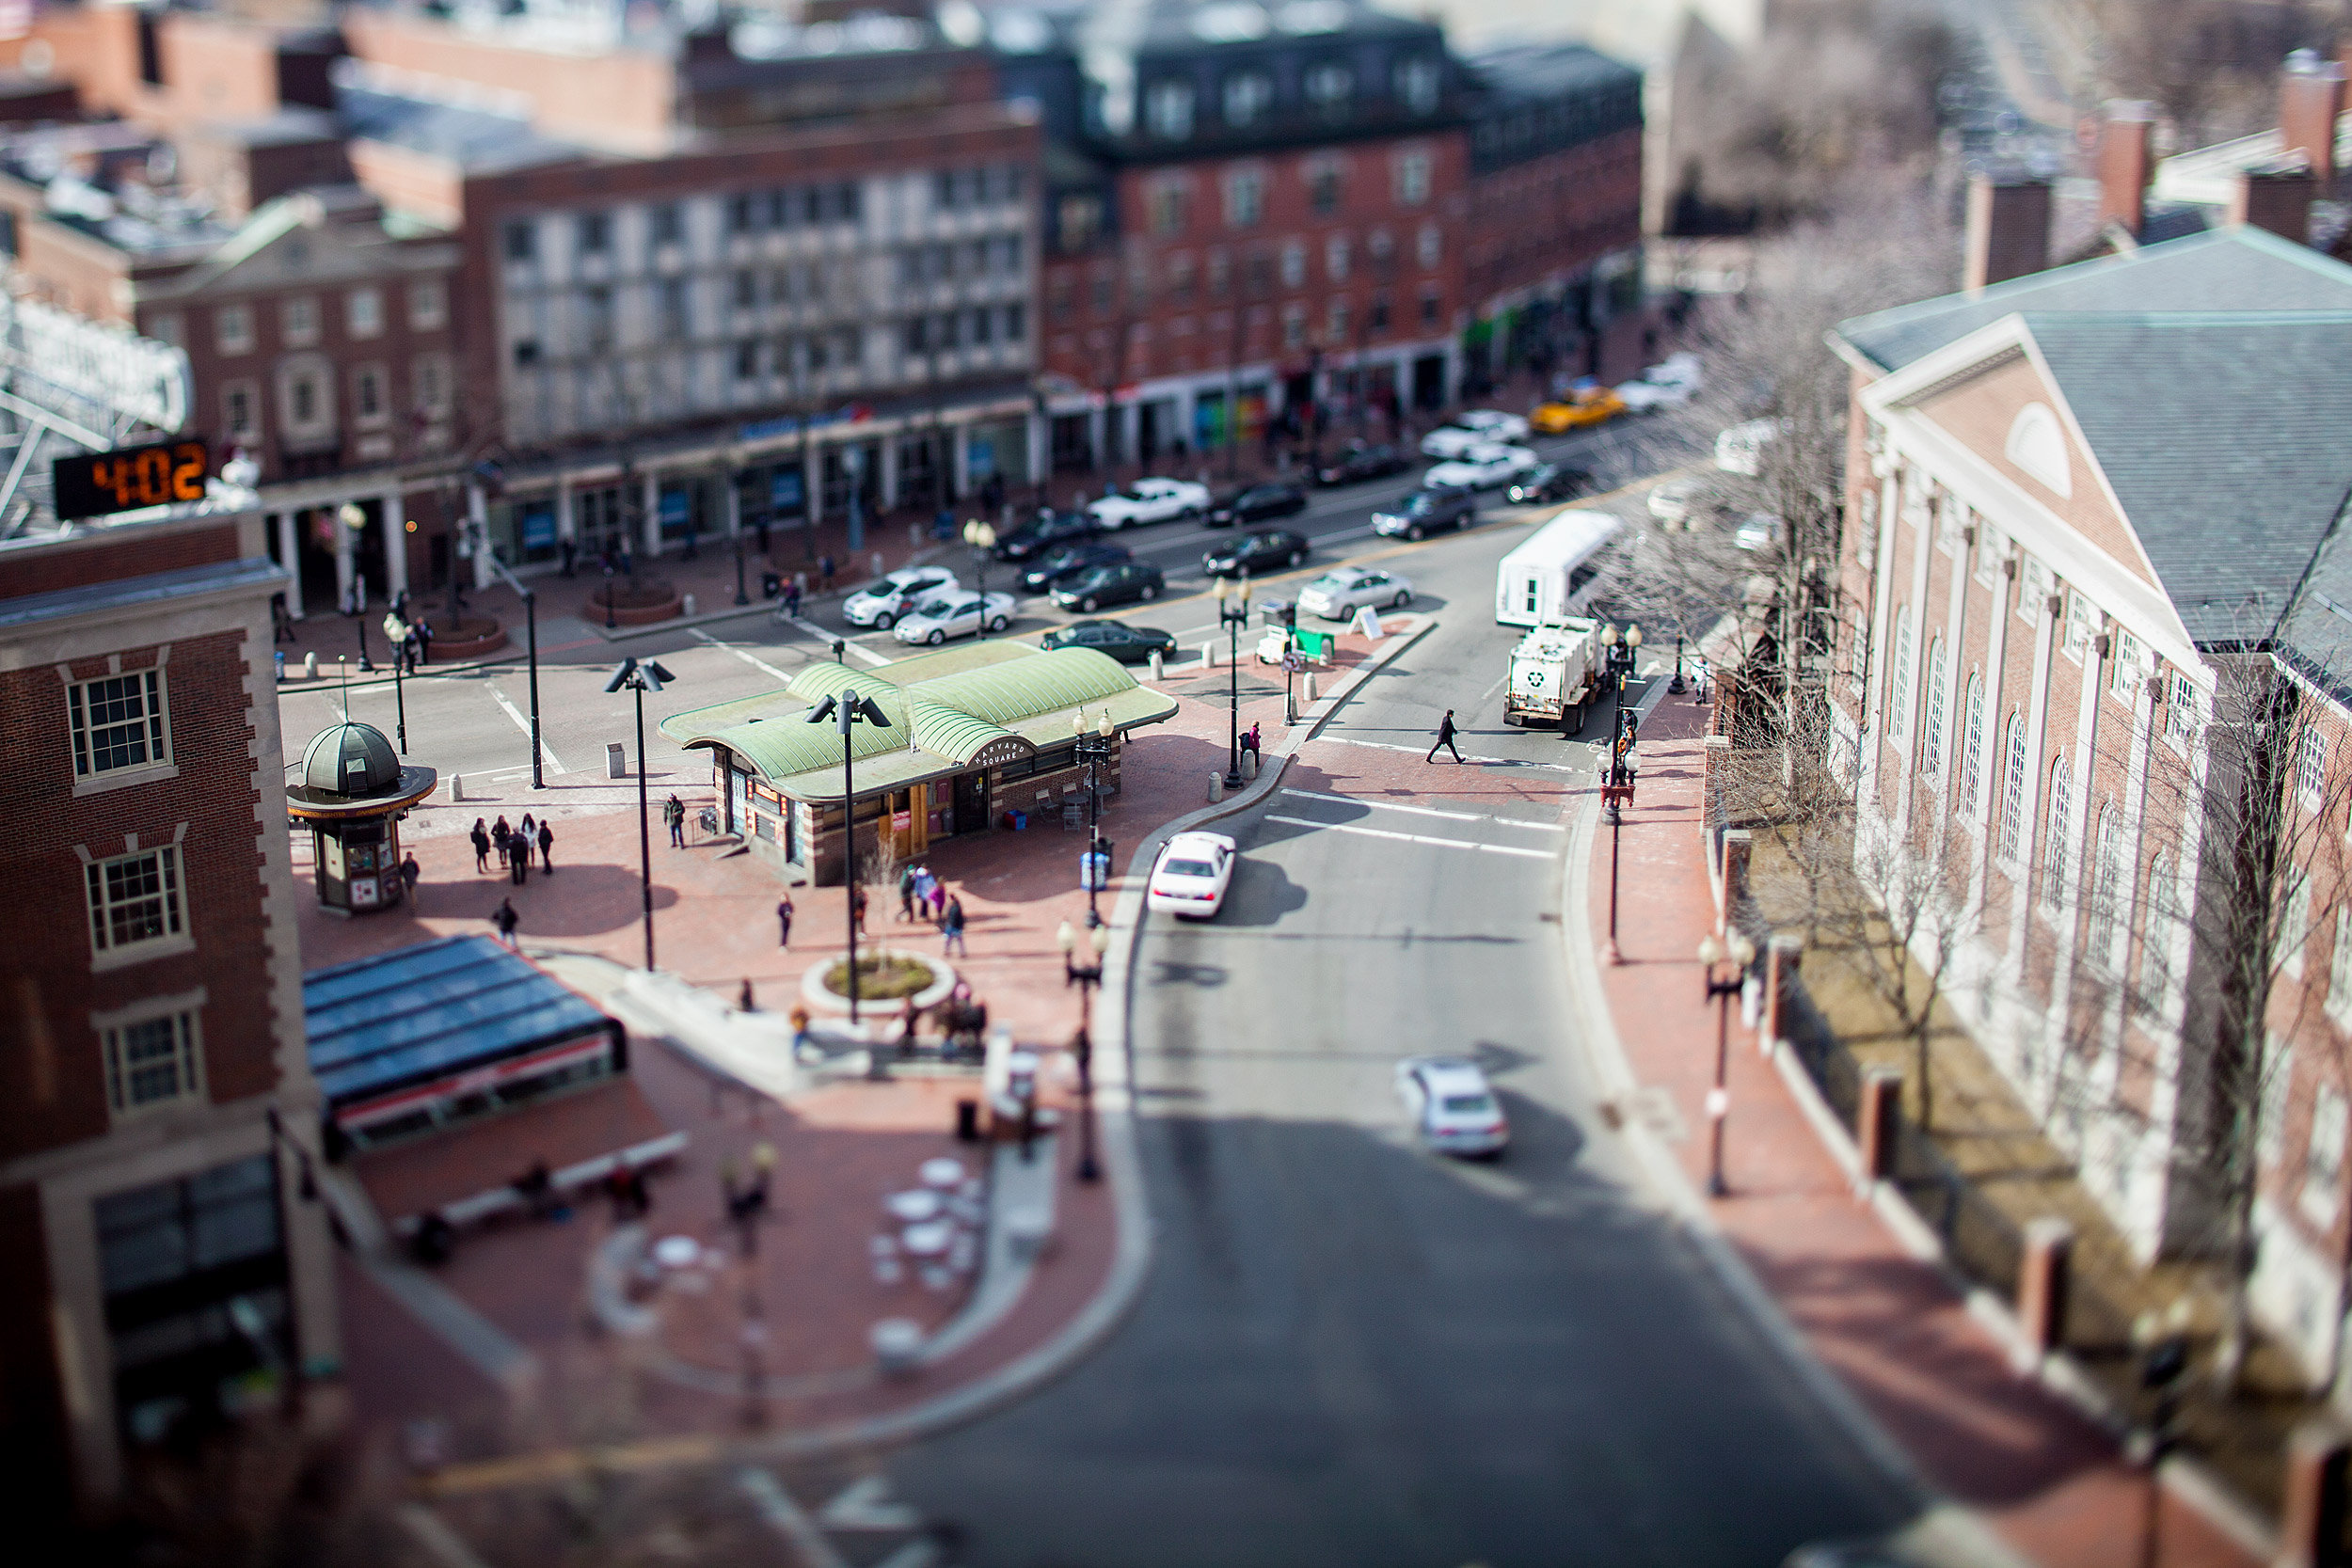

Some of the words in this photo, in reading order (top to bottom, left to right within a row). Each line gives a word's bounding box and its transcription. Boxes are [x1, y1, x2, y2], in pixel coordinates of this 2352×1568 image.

[92, 441, 206, 507] 4:02
[975, 742, 1025, 764] HARVARD
[982, 752, 1016, 767] SQUARE
